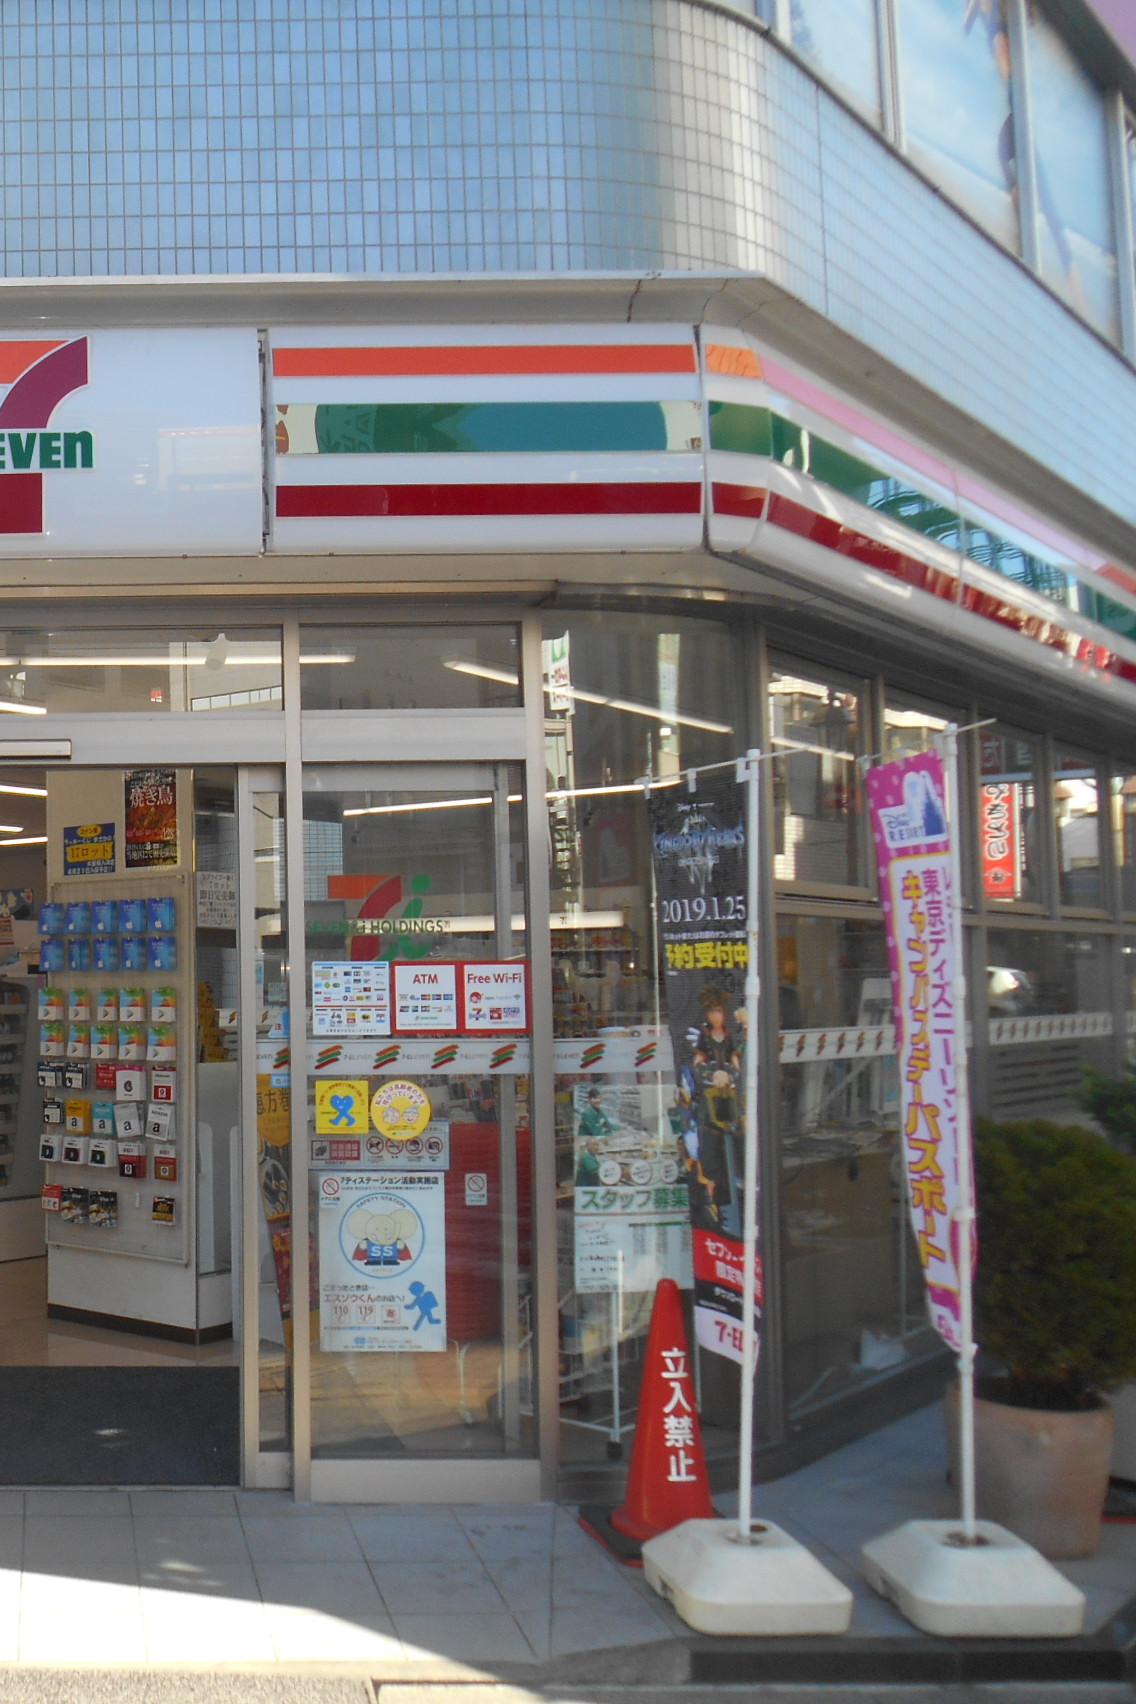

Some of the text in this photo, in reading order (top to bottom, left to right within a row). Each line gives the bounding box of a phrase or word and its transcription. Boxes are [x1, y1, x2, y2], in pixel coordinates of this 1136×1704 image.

[663, 895, 746, 923] 2019.1.25
[412, 973, 439, 985] ATM
[467, 972, 523, 984] Free Wi-Fi
[581, 1187, 689, 1210] スタッフ募集
[370, 1245, 394, 1257] SS
[661, 1346, 698, 1483] 立入禁止
